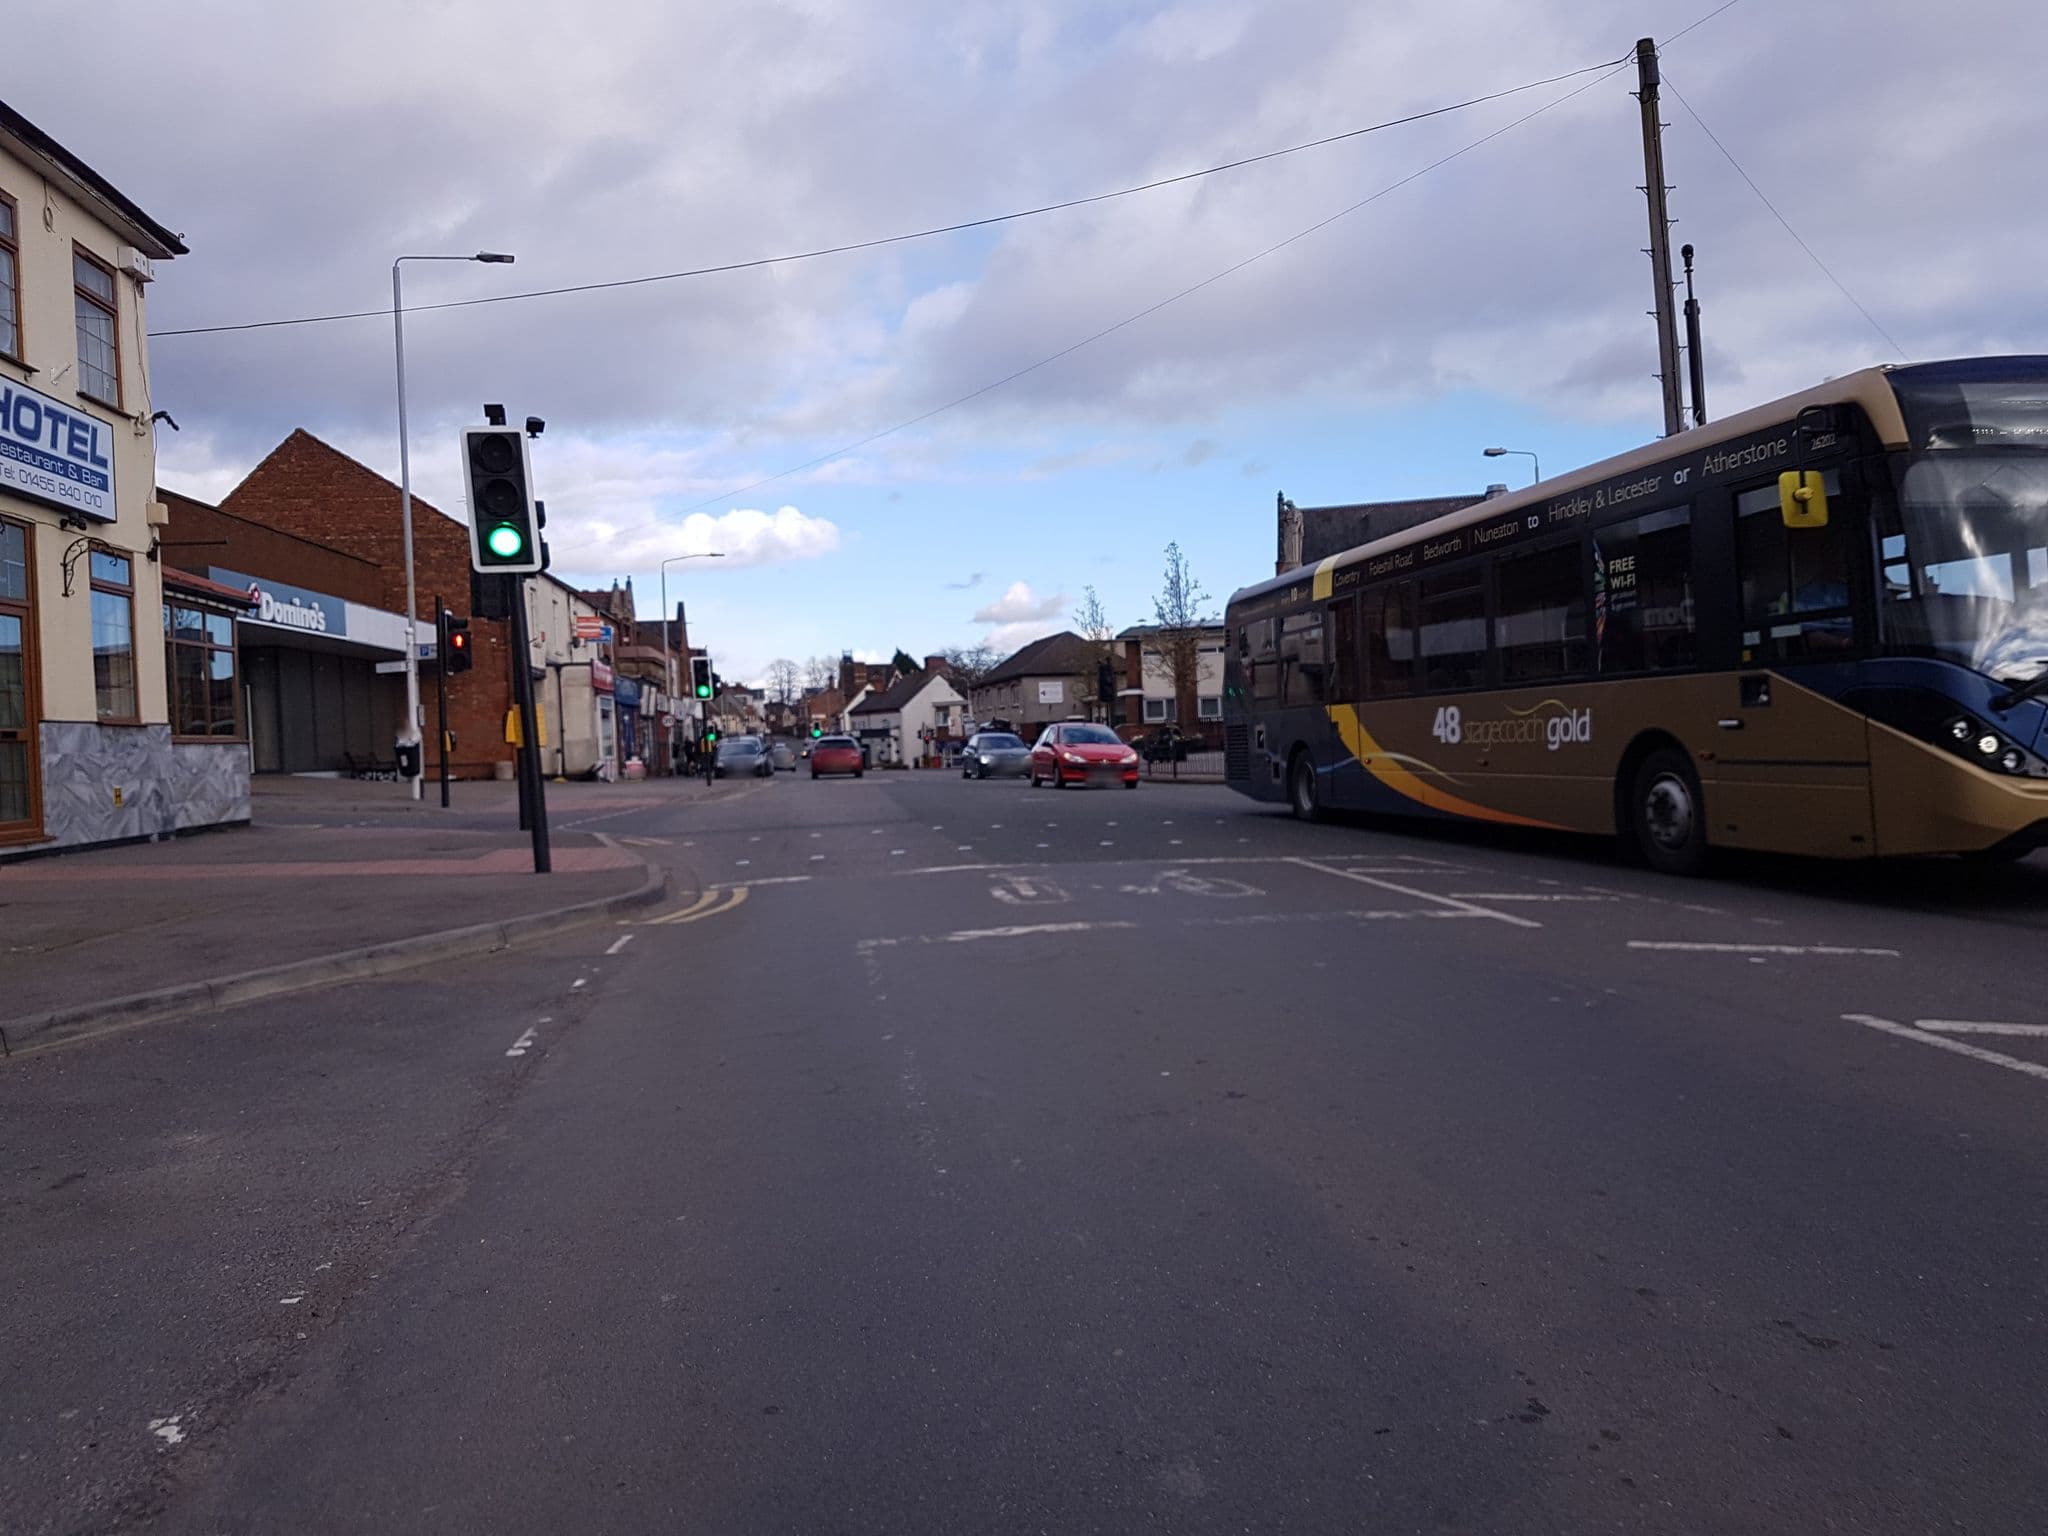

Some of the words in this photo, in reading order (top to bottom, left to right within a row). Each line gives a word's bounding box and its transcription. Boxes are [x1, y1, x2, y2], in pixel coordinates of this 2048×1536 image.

[0, 442, 63, 474] estaurant
[67, 464, 78, 480] &
[82, 469, 103, 487] Bar
[19, 469, 55, 493] 01455
[59, 482, 81, 501] 840
[84, 491, 102, 508] 010
[1335, 570, 1361, 587] Coventry
[1395, 552, 1414, 569] Road
[1424, 536, 1462, 561] Bedworth
[1474, 520, 1519, 545] Nuneaton
[1527, 515, 1540, 529] to
[1549, 498, 1593, 523] Hinckley
[1596, 490, 1606, 509] &
[1608, 475, 1662, 506] Leicester
[1673, 467, 1690, 485] or
[1702, 437, 1788, 478] Atherstone
[1609, 556, 1636, 574] FREE
[1610, 573, 1636, 590] WI-FI
[259, 592, 326, 631] Domino's
[1432, 705, 1461, 744] 48
[1464, 714, 1545, 752] stagecoach
[1547, 707, 1591, 751] gold
